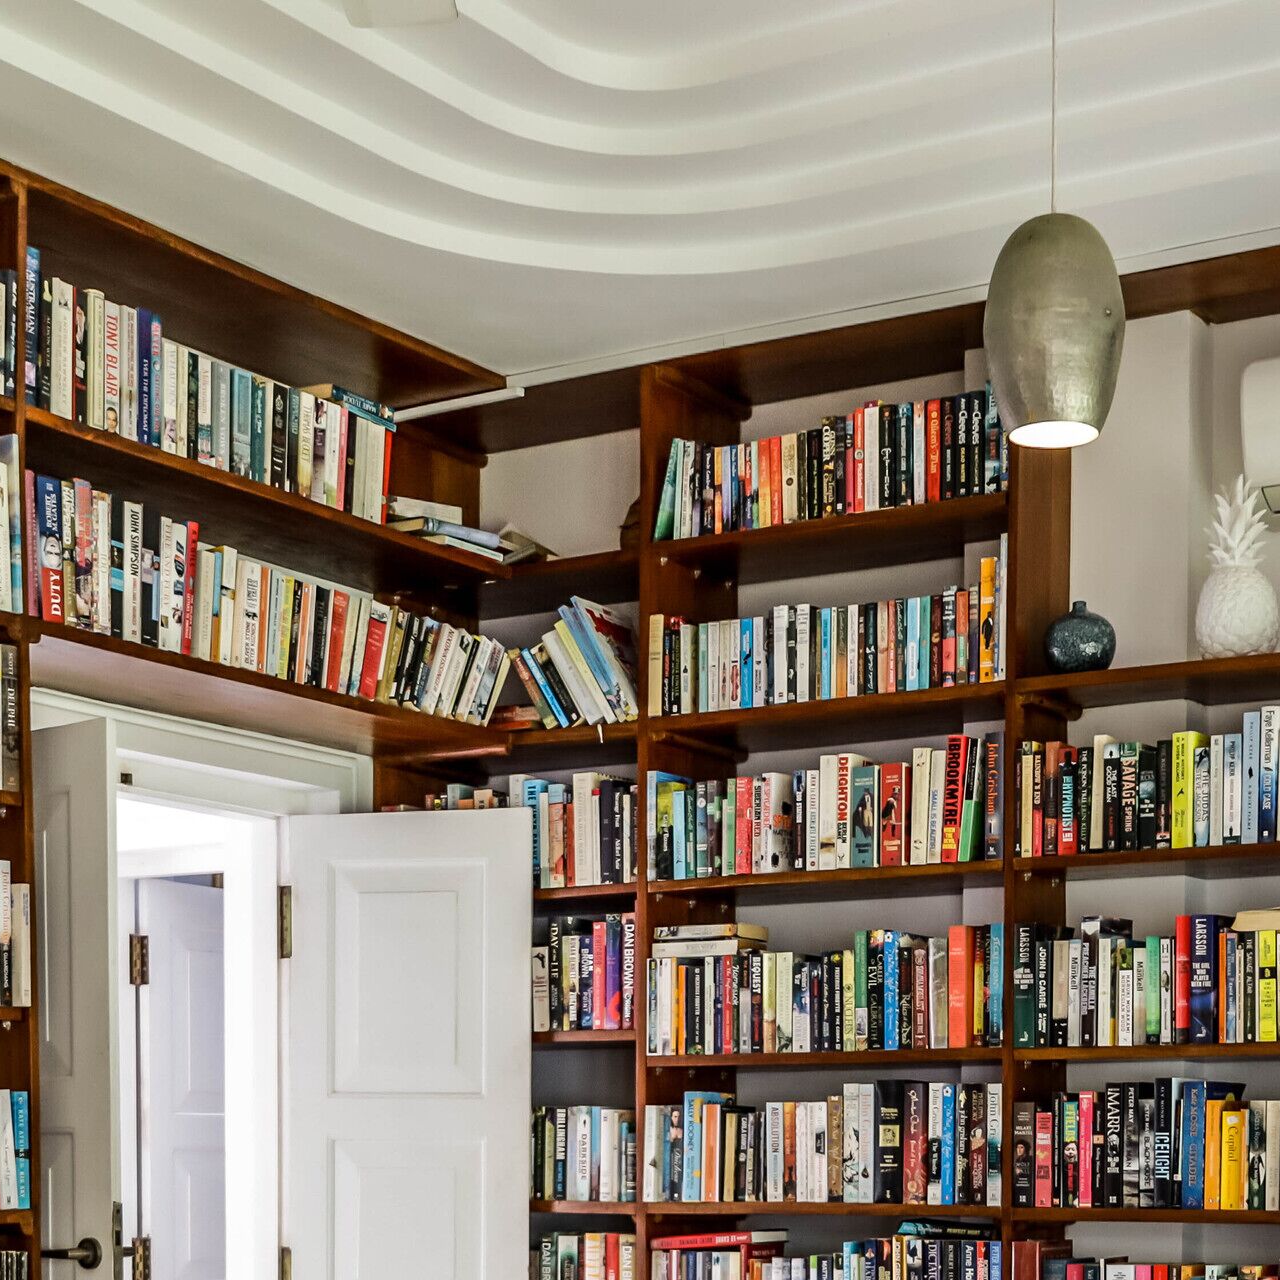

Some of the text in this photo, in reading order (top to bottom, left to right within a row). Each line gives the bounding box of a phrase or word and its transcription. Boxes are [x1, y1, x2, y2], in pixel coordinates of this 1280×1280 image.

[105, 314, 118, 397] TONY BLAIR
[128, 510, 140, 578] JOHN SIMPSON
[50, 572, 61, 616] DUTY
[838, 756, 848, 822] DEIGHTON
[987, 770, 995, 813] Grisham
[1062, 784, 1071, 830] HYPNOTIST
[1122, 760, 1133, 832] SAVAGE SPRING
[624, 924, 634, 988] DAN BROWN
[1020, 927, 1029, 963] LARSSON
[1195, 919, 1206, 956] LARSSON
[752, 958, 761, 992] BEQUEST
[1070, 958, 1078, 990] Mankell
[1156, 1132, 1169, 1180] ICELIGHT
[1227, 1127, 1237, 1162] Capital
